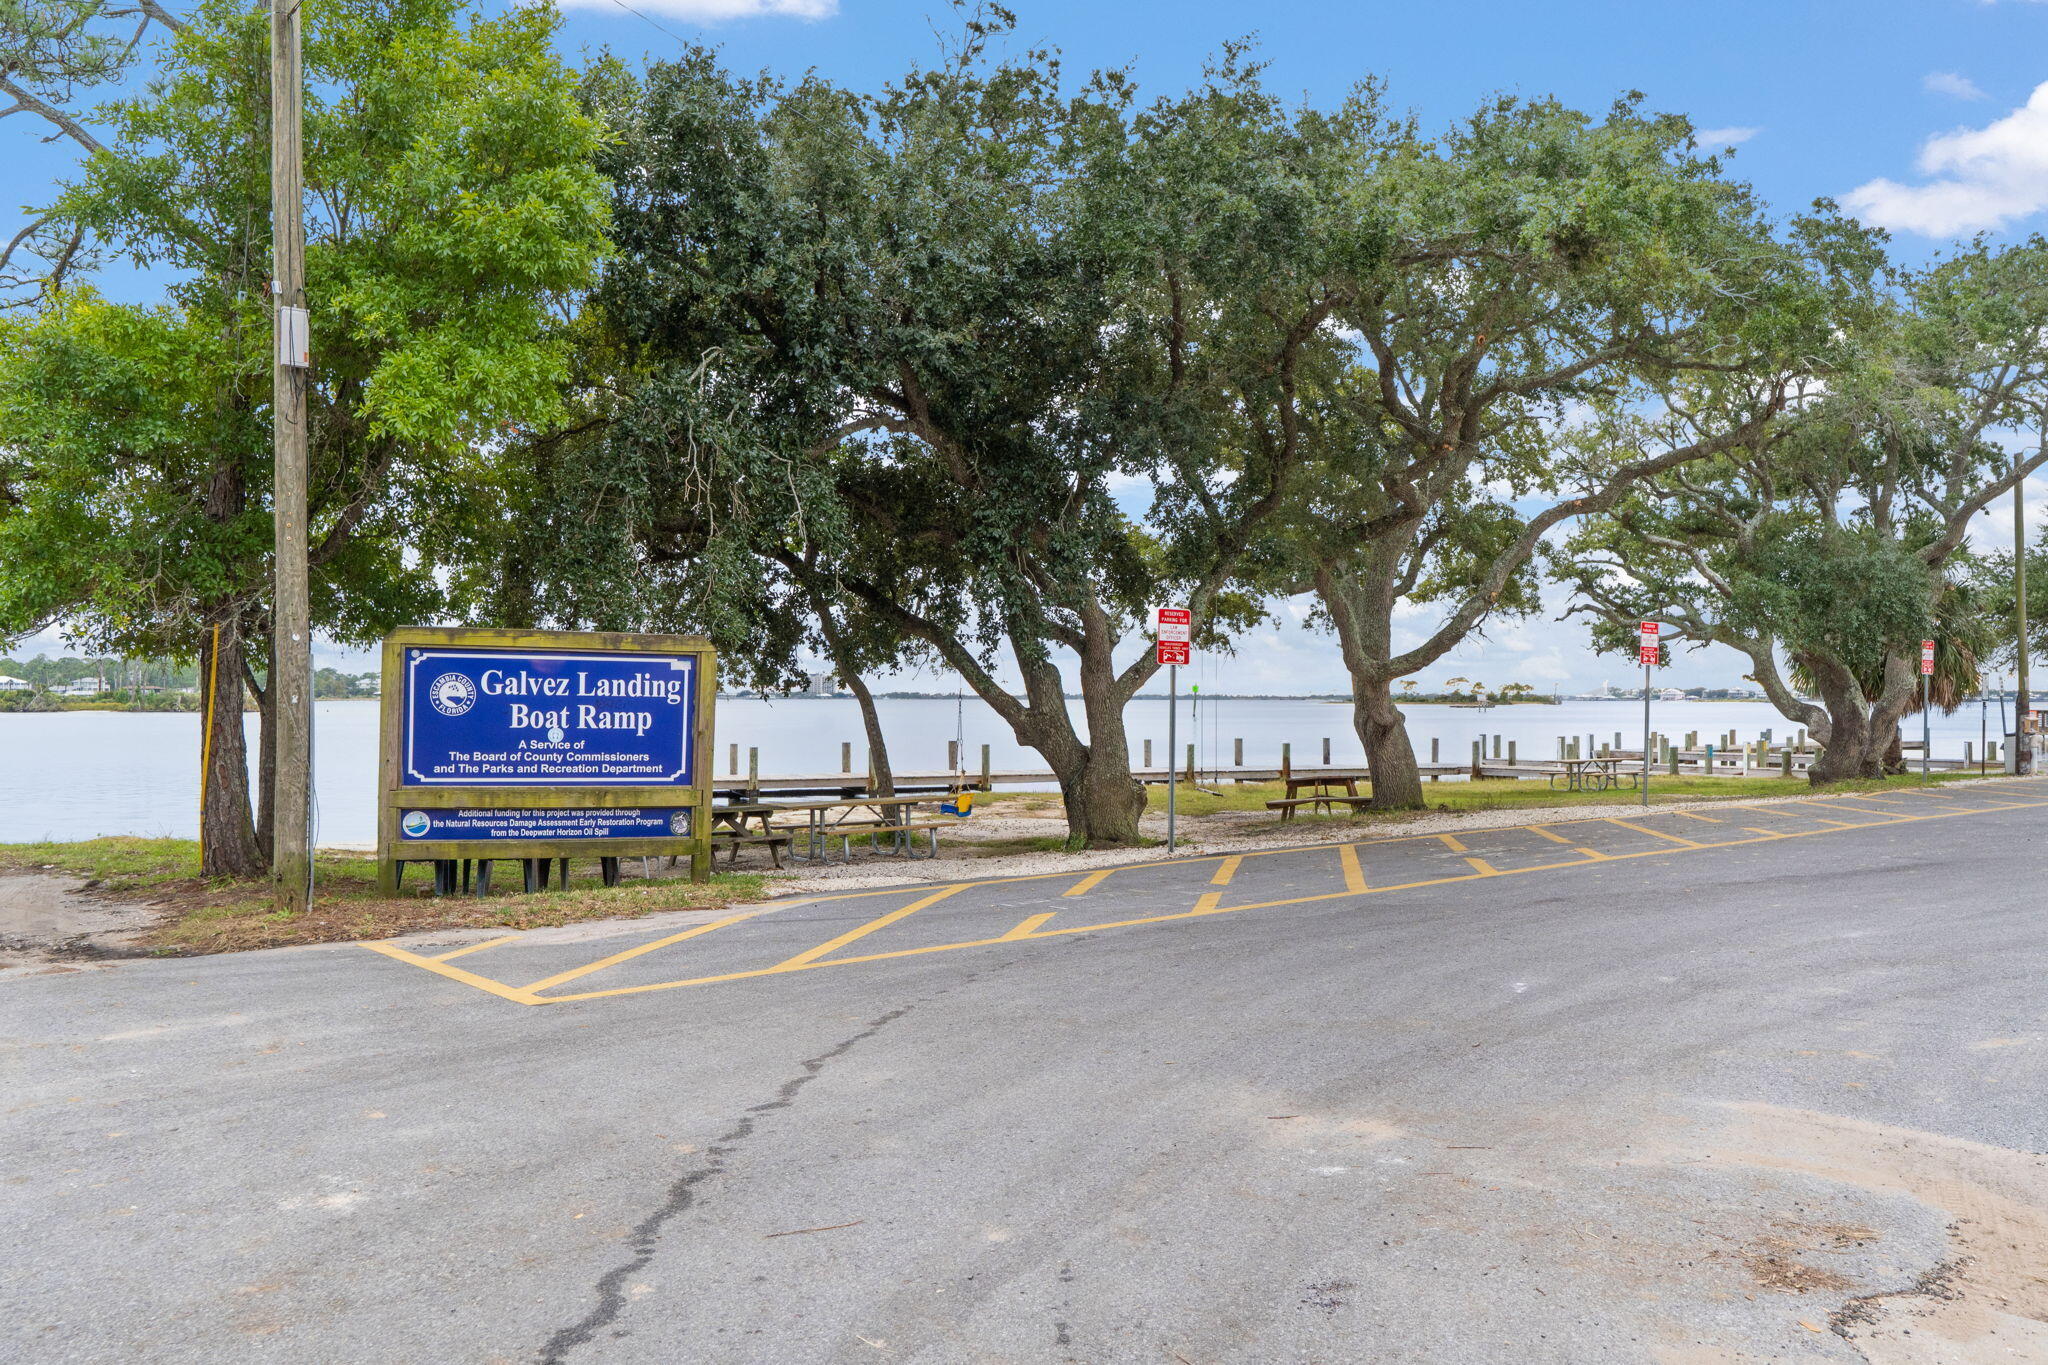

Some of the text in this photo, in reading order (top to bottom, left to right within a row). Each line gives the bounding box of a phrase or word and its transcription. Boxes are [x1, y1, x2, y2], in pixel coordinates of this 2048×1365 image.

[432, 675, 475, 700] ESCAMBIA COUNTY
[480, 669, 681, 705] Galvez Landing
[438, 704, 469, 715] FLORIDA
[509, 703, 652, 737] Boat Ramp
[518, 739, 585, 750] A Service of
[449, 751, 650, 764] The Board of County Commissioners
[433, 764, 663, 775] and The Parks and Recreation Department
[494, 809, 520, 818] funding
[522, 809, 531, 817] for
[532, 809, 545, 817] this
[546, 809, 570, 818] project
[586, 808, 614, 818] provided
[615, 808, 640, 818] through
[433, 820, 444, 828] the
[509, 819, 536, 828] Damage
[538, 819, 578, 827] Assessment
[580, 818, 596, 828] Early
[598, 818, 634, 826] Restoration
[636, 818, 664, 828] Program
[520, 828, 556, 838] Deepwater
[556, 828, 582, 836] Horizon
[594, 828, 609, 836] Spill
